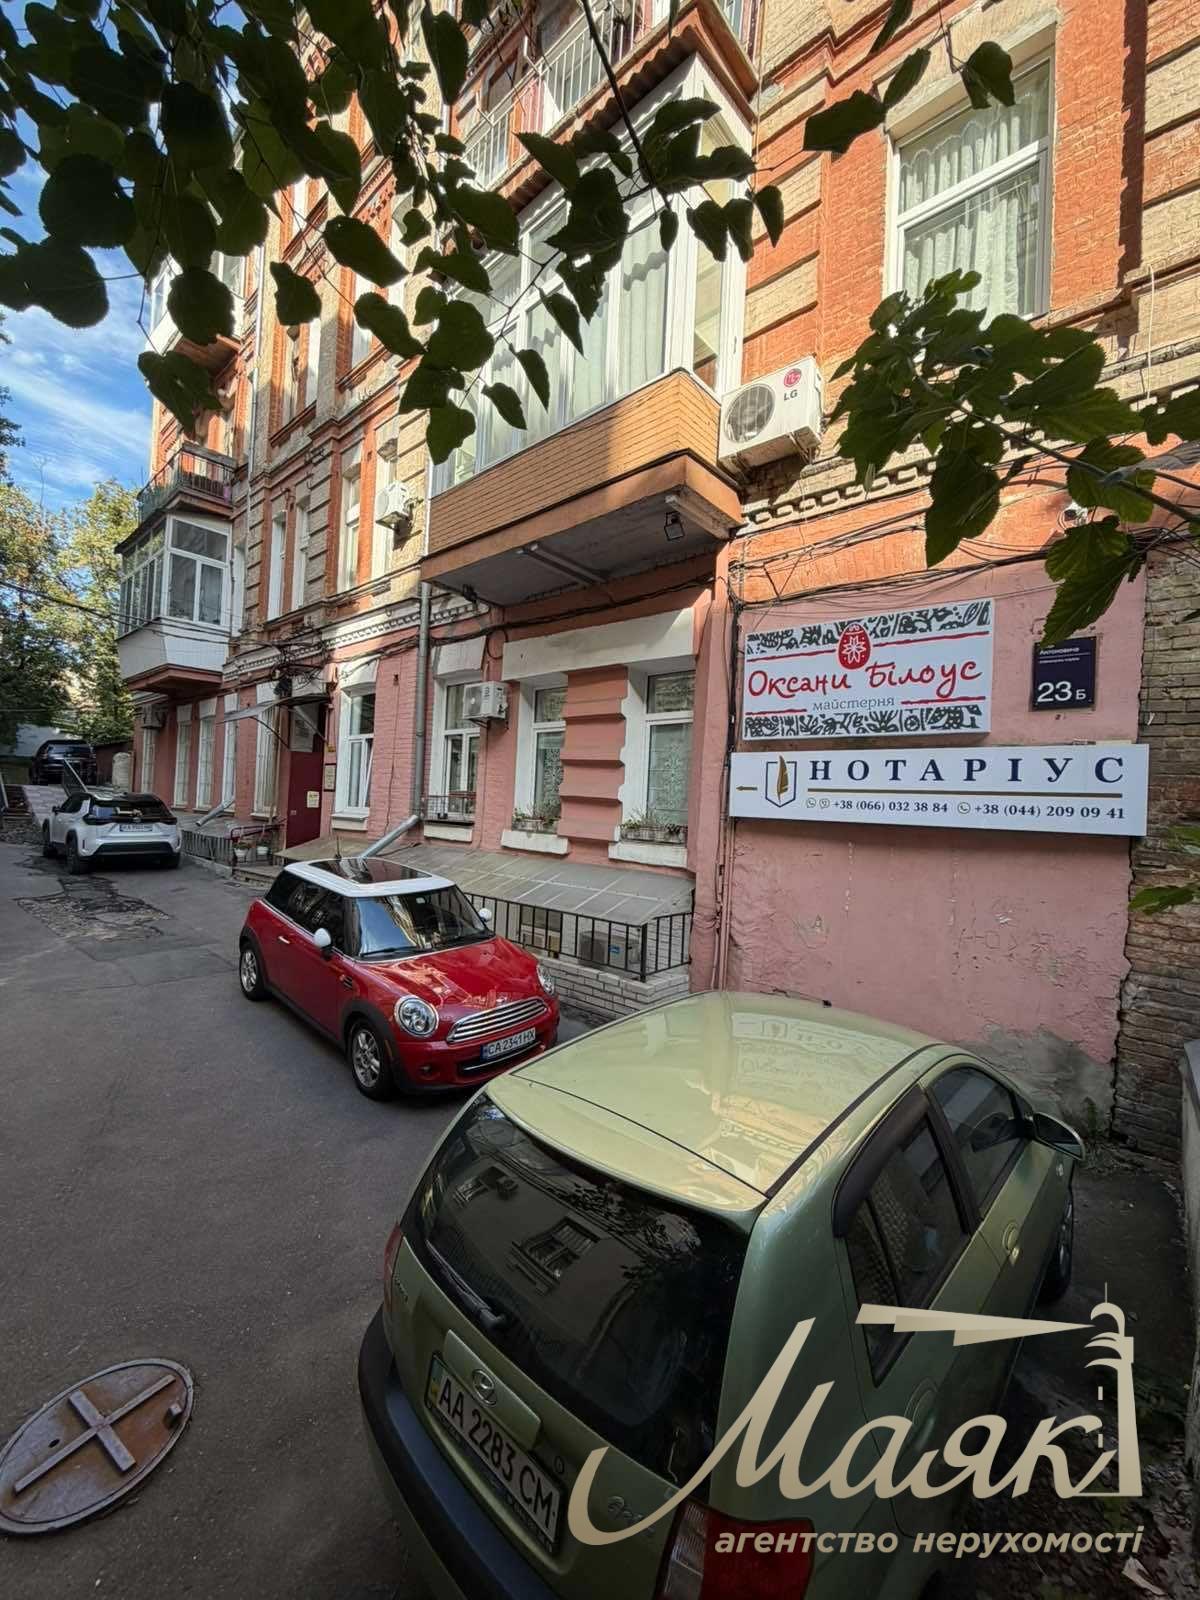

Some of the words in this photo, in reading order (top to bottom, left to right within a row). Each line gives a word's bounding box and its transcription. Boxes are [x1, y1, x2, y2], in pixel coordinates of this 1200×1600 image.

[784, 389, 798, 401] LG
[748, 670, 852, 699] Оксани
[865, 660, 983, 699] Білоус
[812, 697, 896, 712] майстерня
[809, 757, 1124, 784] НОТАРІУС
[834, 800, 853, 810] +38
[856, 800, 885, 811] (066)
[888, 801, 910, 812] 032
[913, 801, 929, 812] 38
[932, 802, 948, 813] 84
[974, 803, 999, 815] +38
[1003, 804, 1041, 818] (044)
[1046, 805, 1075, 818] 209
[1080, 806, 1100, 819] 09
[1106, 807, 1126, 819] 41
